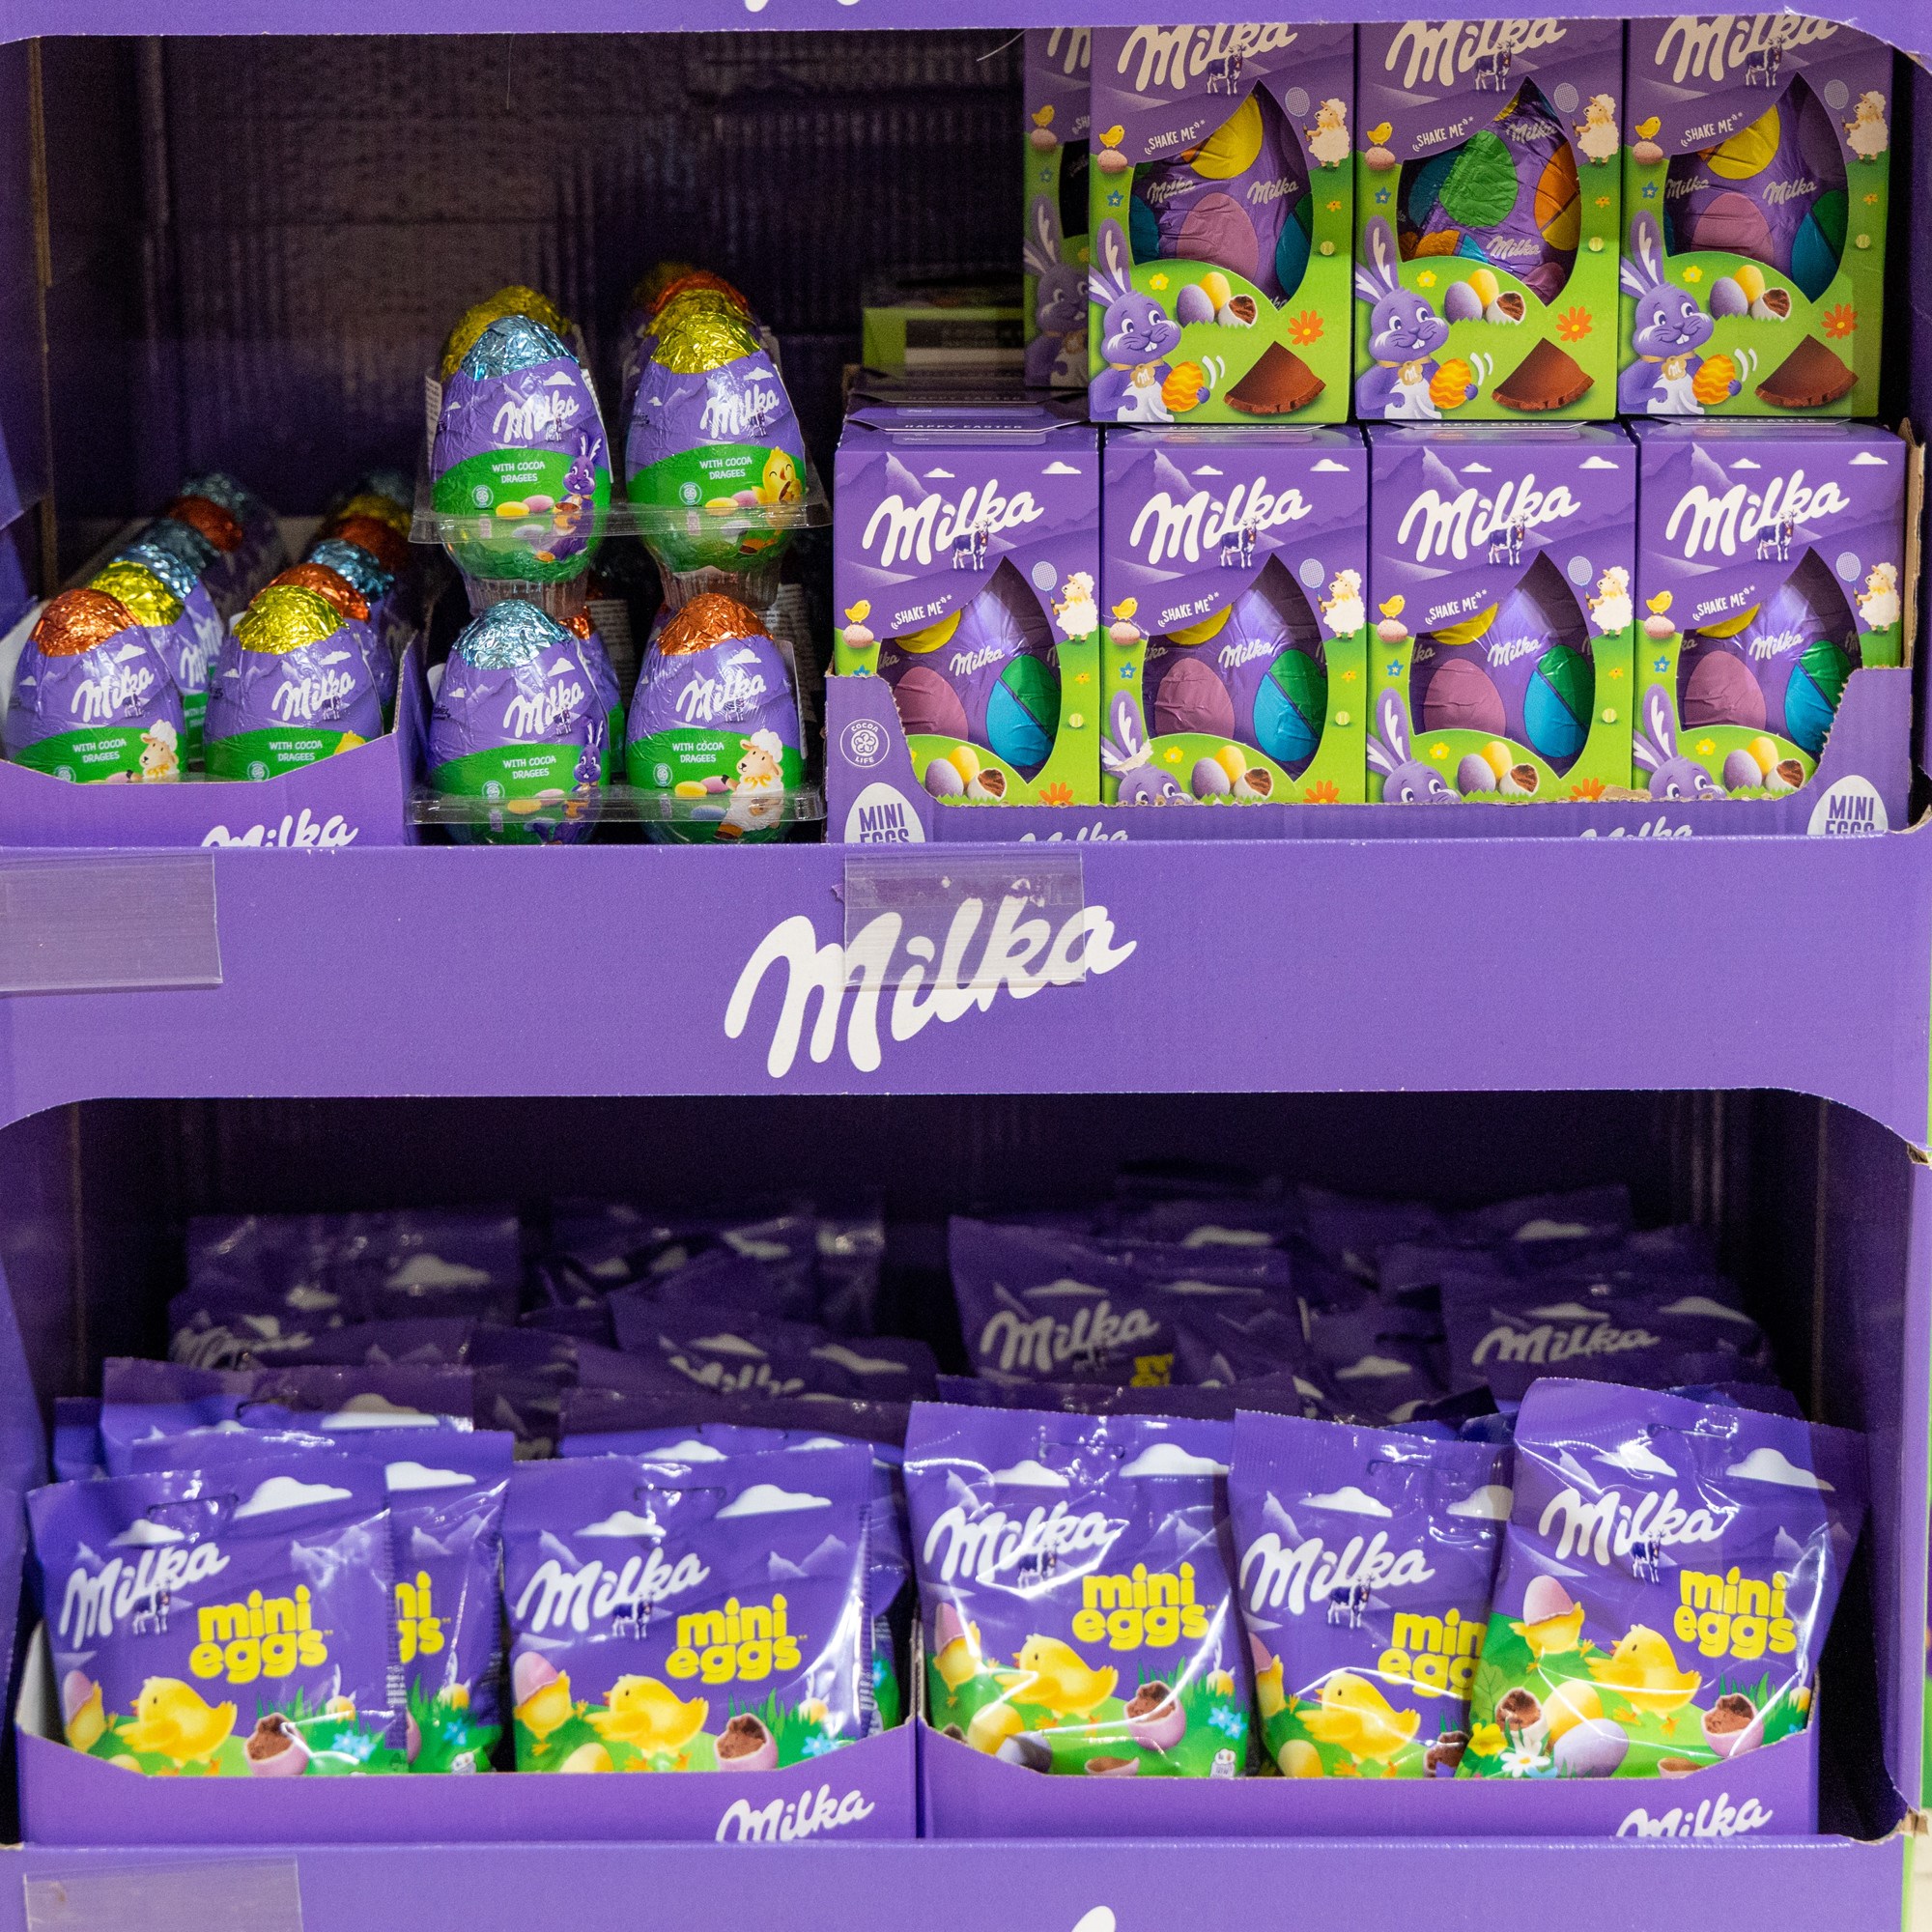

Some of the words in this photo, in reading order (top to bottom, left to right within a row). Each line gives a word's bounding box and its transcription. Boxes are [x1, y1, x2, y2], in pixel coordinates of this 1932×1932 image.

[1118, 24, 1298, 92] Milka
[1385, 19, 1567, 89] Milka
[1655, 14, 1838, 83] Milka
[1148, 132, 1179, 151] SHAKE
[1416, 128, 1447, 148] SHAKE
[1685, 124, 1715, 143] SHAKE
[1147, 179, 1197, 205] Milka
[1247, 177, 1299, 205] Milka
[1665, 176, 1710, 199] Milka
[1762, 177, 1817, 207] Milka
[1486, 236, 1542, 260] Milka
[699, 384, 781, 439] Milka
[492, 464, 516, 473] WITH
[517, 461, 545, 470] COCOA
[500, 473, 538, 484] DRAGEES
[699, 460, 724, 469] WITH
[725, 456, 753, 467] COCOA
[709, 469, 746, 480] DRAGEES
[862, 479, 1044, 566] Milka
[1129, 476, 1312, 564] Milka
[1398, 473, 1580, 562] Milka
[1665, 469, 1850, 557] Milka
[895, 607, 925, 626] SHAKE
[1161, 604, 1193, 623] SHAKE
[1429, 601, 1460, 620] SHAKE
[1696, 597, 1728, 616] SHAKE
[949, 645, 1005, 677] Milka
[1218, 639, 1273, 669] Milka
[1488, 636, 1542, 668] Milka
[1748, 631, 1804, 661] Milka
[71, 666, 155, 723] Milka
[271, 669, 355, 722] Milka
[502, 679, 584, 738] Milka
[675, 668, 767, 723] Milka
[72, 741, 97, 753] WITH
[99, 738, 127, 750] COCOA
[269, 741, 292, 751] WITH
[295, 740, 323, 750] COCOA
[672, 743, 694, 752] WITH
[696, 741, 724, 751] COCOA
[850, 723, 879, 733] COCOA
[82, 752, 121, 763] DRAGEES
[277, 753, 315, 762] DRAGEES
[502, 758, 526, 769] WITH
[528, 755, 556, 766] COCOA
[512, 768, 550, 780] DRAGEES
[680, 754, 716, 763] DRAGEES
[859, 803, 905, 832] MINI
[1829, 795, 1874, 821] MINI
[724, 881, 1137, 1078] Milka
[980, 1299, 1158, 1373] Milka
[1472, 1322, 1661, 1365] Milka
[923, 1501, 1119, 1582] Milka
[1539, 1488, 1728, 1567] Milka
[515, 1546, 711, 1634] Milka
[1082, 1562, 1196, 1609] mini
[1239, 1530, 1435, 1615] Milka
[1679, 1566, 1788, 1617] mini
[59, 1543, 231, 1650] Milka
[198, 1584, 312, 1642] mini
[394, 1571, 432, 1619] ni
[677, 1592, 787, 1648] mini
[1071, 1605, 1209, 1651] eggs
[1391, 1607, 1488, 1657] min
[1674, 1610, 1797, 1659] eggs
[189, 1629, 328, 1684] eggs
[666, 1635, 801, 1684] eggs
[1378, 1647, 1480, 1701] egg
[715, 1784, 875, 1842] Milka
